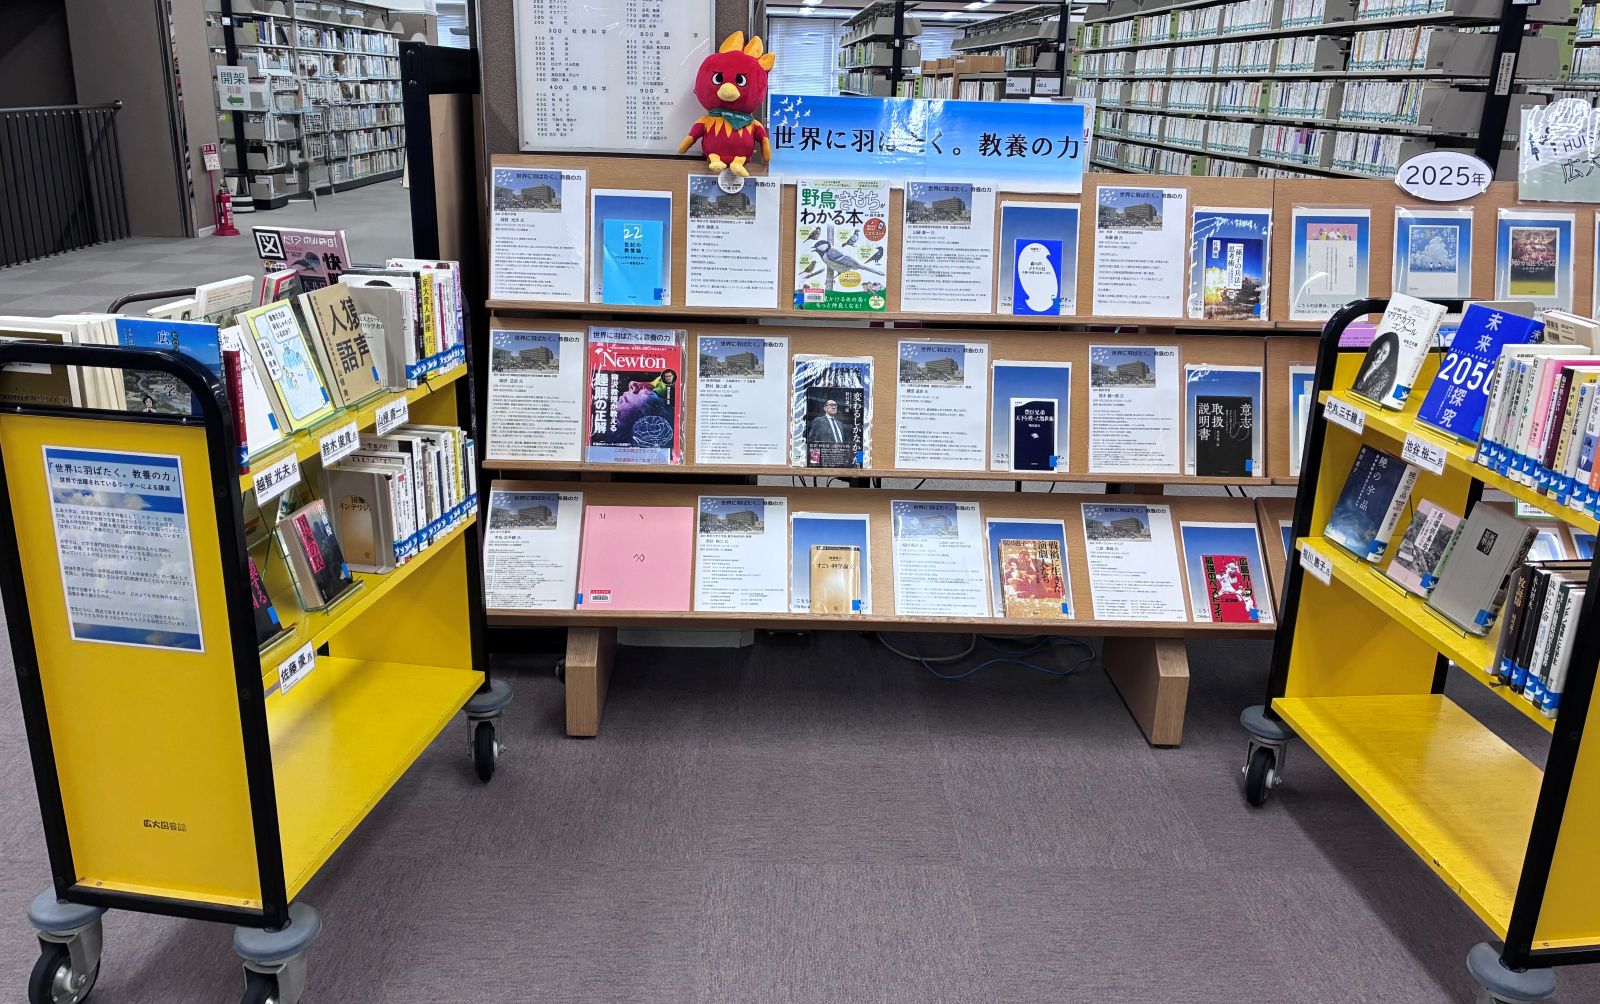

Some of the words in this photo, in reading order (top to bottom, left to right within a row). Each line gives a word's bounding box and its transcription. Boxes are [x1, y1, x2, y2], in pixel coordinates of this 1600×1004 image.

[220, 71, 246, 85] 開架
[1405, 164, 1486, 187] 2025年
[801, 188, 886, 211] 野鳥のきもちが
[800, 208, 864, 227] わかる本
[255, 231, 285, 259] 図
[623, 226, 644, 239] 22
[422, 277, 432, 333] 京大変人講座
[329, 303, 360, 375] 人語
[592, 331, 671, 342] 世界に羽ばたく。教養の力
[1474, 312, 1504, 353] 未来
[602, 351, 666, 369] Newton
[1211, 403, 1225, 428] 取扱
[1240, 403, 1253, 429] 意志
[1326, 400, 1339, 414] 中丸
[1439, 386, 1468, 428] 探究
[1197, 403, 1211, 441] 説明書
[321, 439, 337, 456] 鈴木
[1405, 439, 1421, 455] 池谷
[1420, 443, 1438, 463] 裕二
[1437, 456, 1443, 467] 氏
[48, 461, 178, 484] 「世界に羽ばたく。教養の力」
[59, 475, 171, 493] 世界で活躍されているリーダーによる講演
[255, 472, 273, 493] 越智
[273, 463, 292, 483] 光夫
[290, 463, 298, 473] 氏
[1359, 456, 1389, 511] 暁の宇品
[280, 660, 297, 685] 佐藤
[297, 652, 306, 667] 優
[307, 650, 313, 662] 氏
